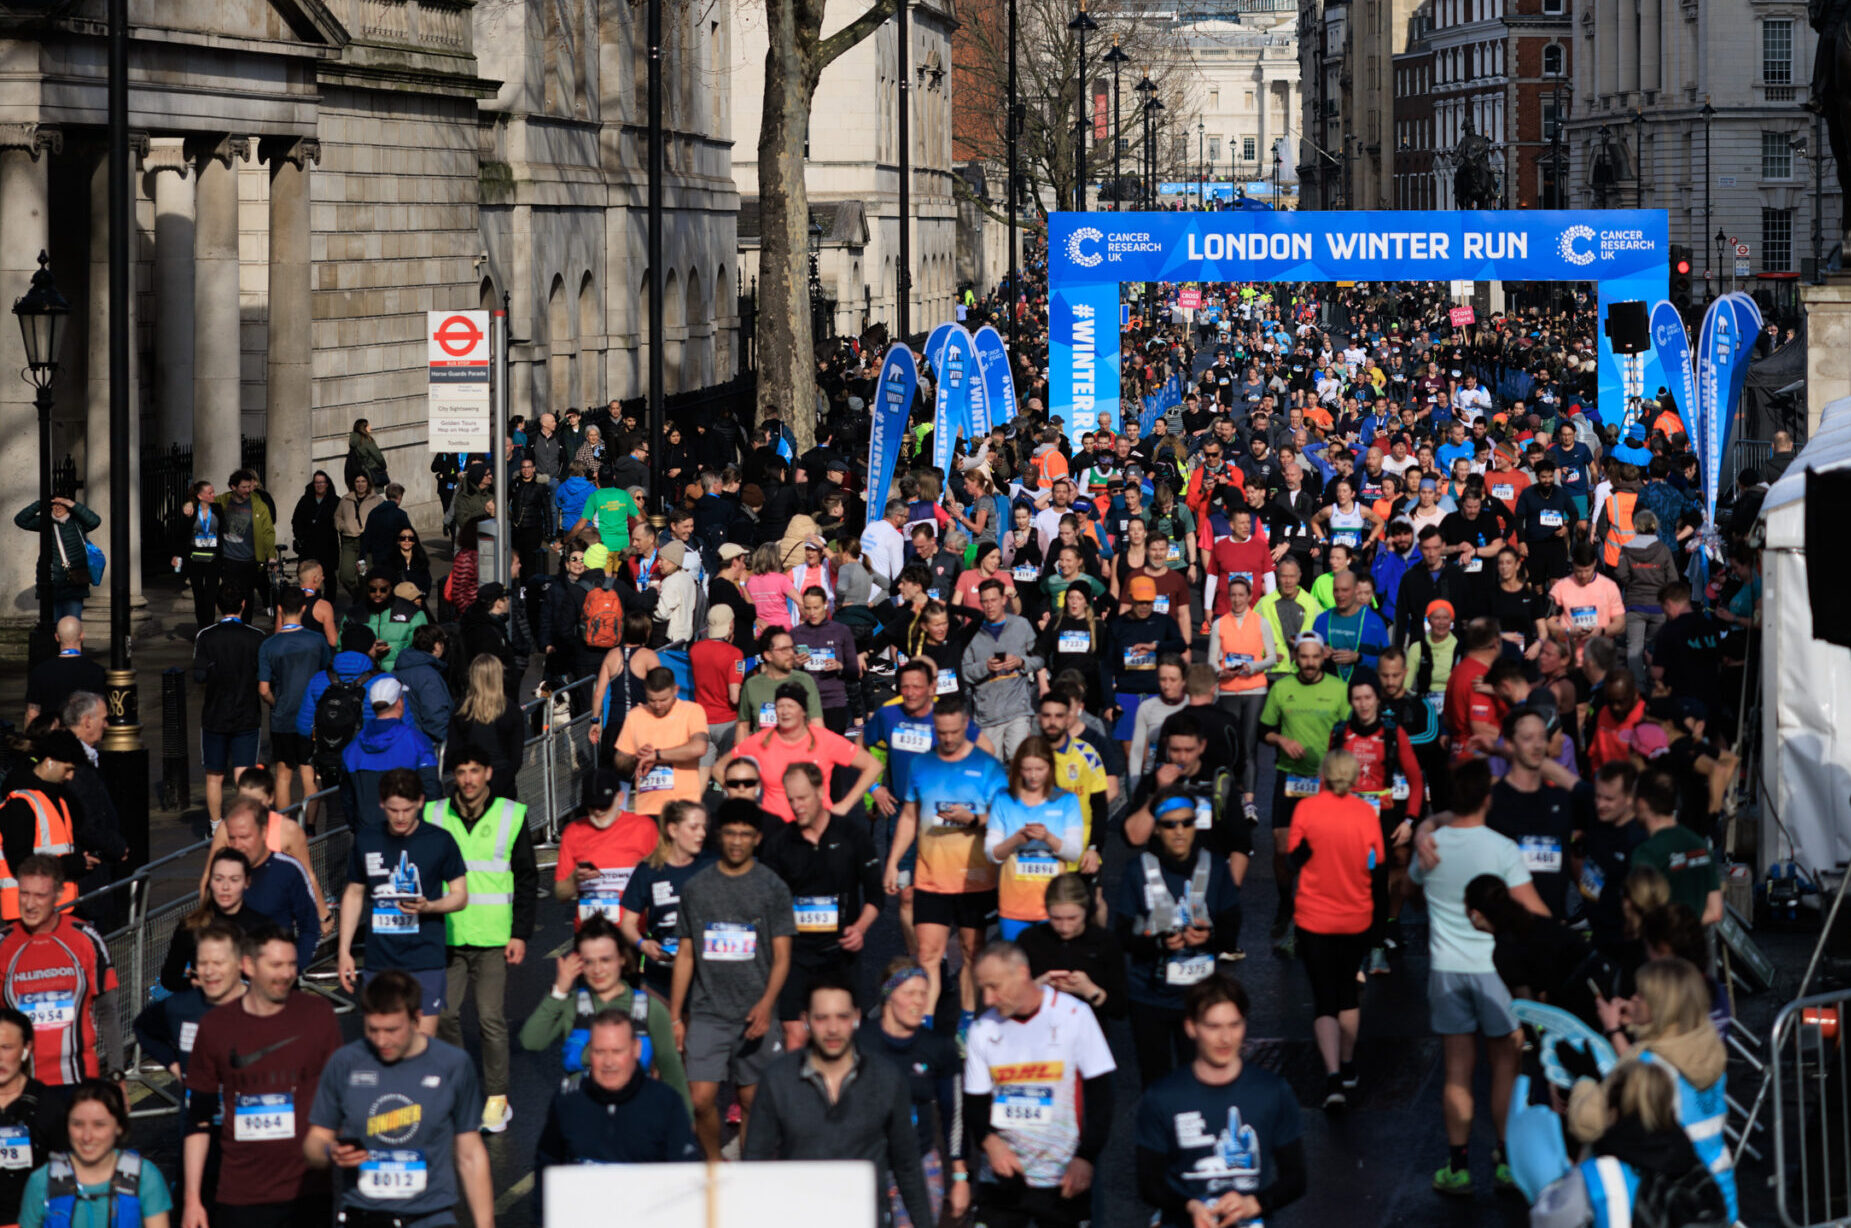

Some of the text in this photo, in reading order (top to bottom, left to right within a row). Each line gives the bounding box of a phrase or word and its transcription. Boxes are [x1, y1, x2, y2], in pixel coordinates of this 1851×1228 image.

[1108, 233, 1150, 242] CANCER
[1600, 230, 1643, 240] CANCER
[1108, 242, 1162, 252] RESEARCH
[1188, 232, 1528, 260] LONDON WINTER RUN
[1600, 240, 1655, 250] RESEARCH
[1108, 252, 1122, 262] UK
[1600, 250, 1616, 260] UK
[996, 1063, 1062, 1082] DHL
